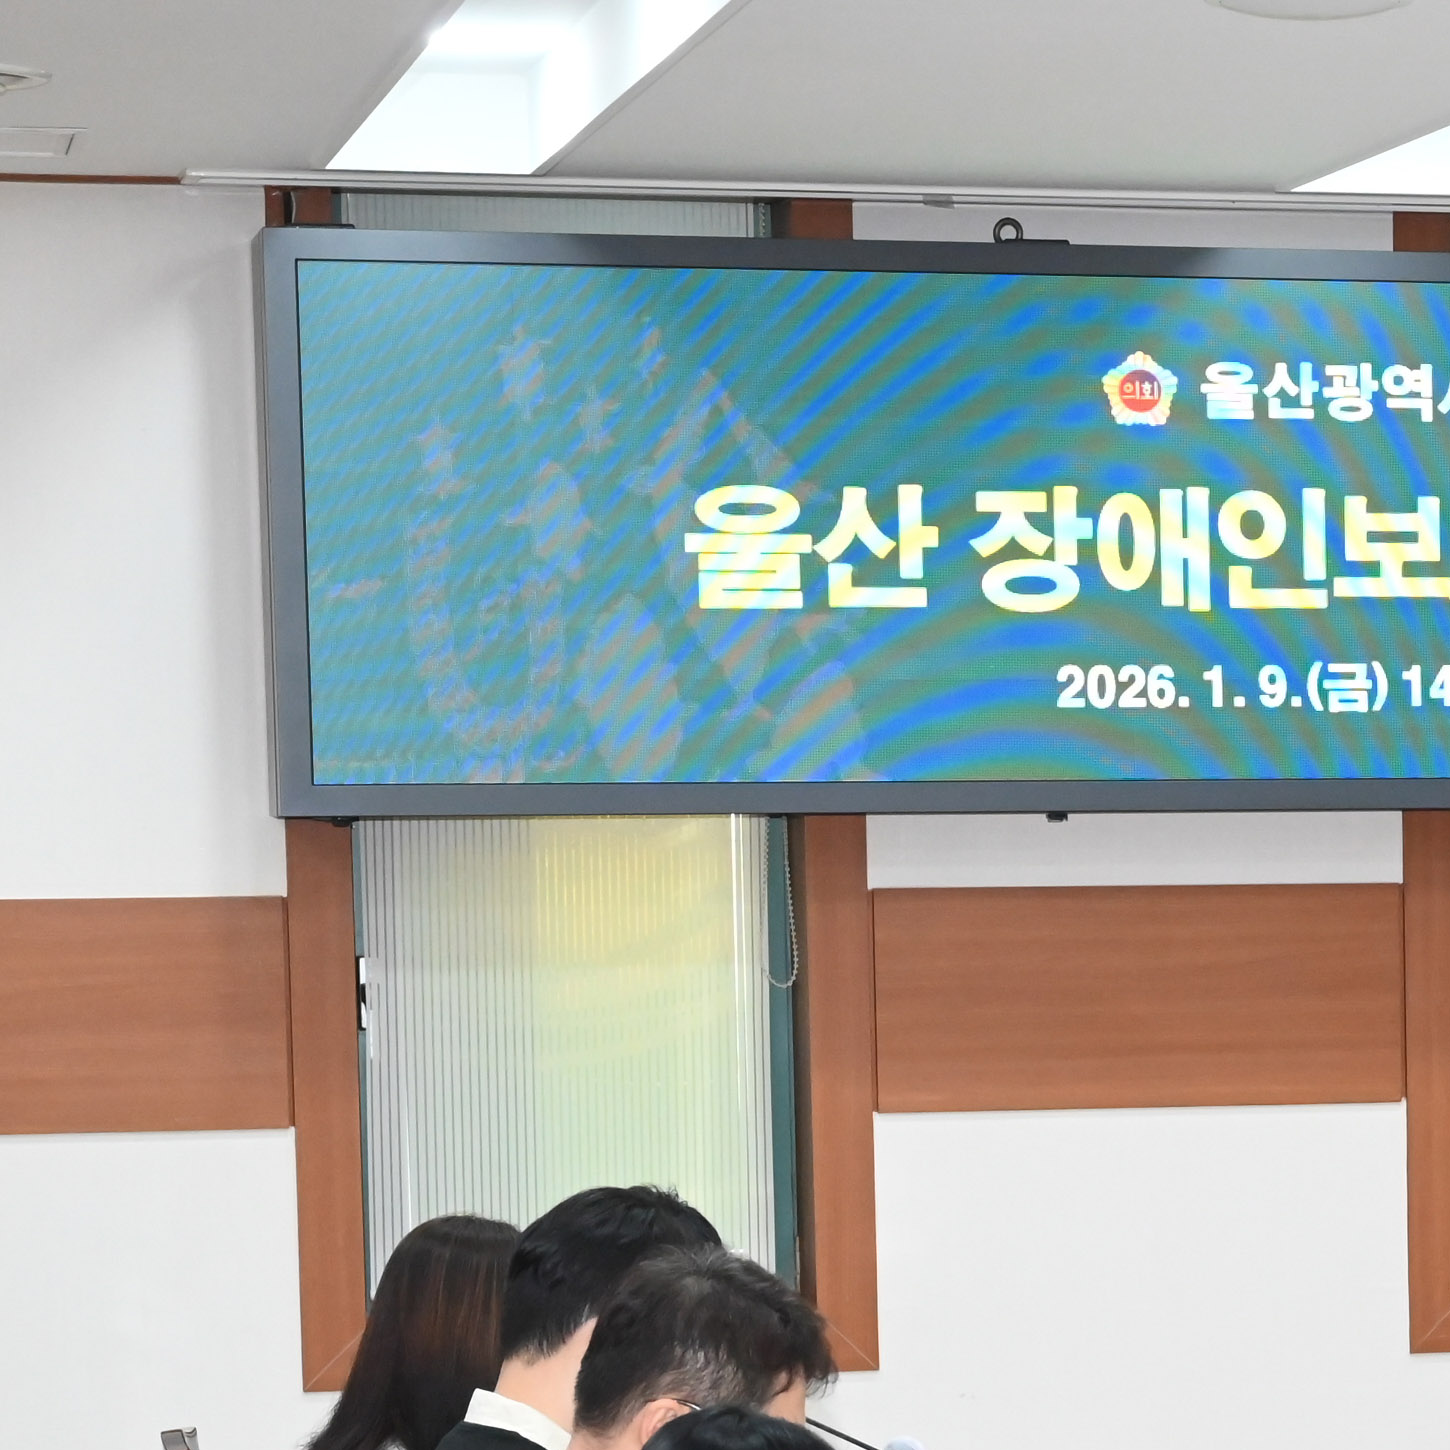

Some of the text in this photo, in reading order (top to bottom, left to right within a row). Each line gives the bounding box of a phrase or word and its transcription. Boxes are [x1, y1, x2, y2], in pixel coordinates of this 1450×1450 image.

[1121, 380, 1159, 400] 의회
[685, 485, 940, 611] 울산
[1057, 664, 1191, 710] 2026.
[1205, 666, 1247, 709] 1.
[1259, 661, 1389, 714] 9.(금)
